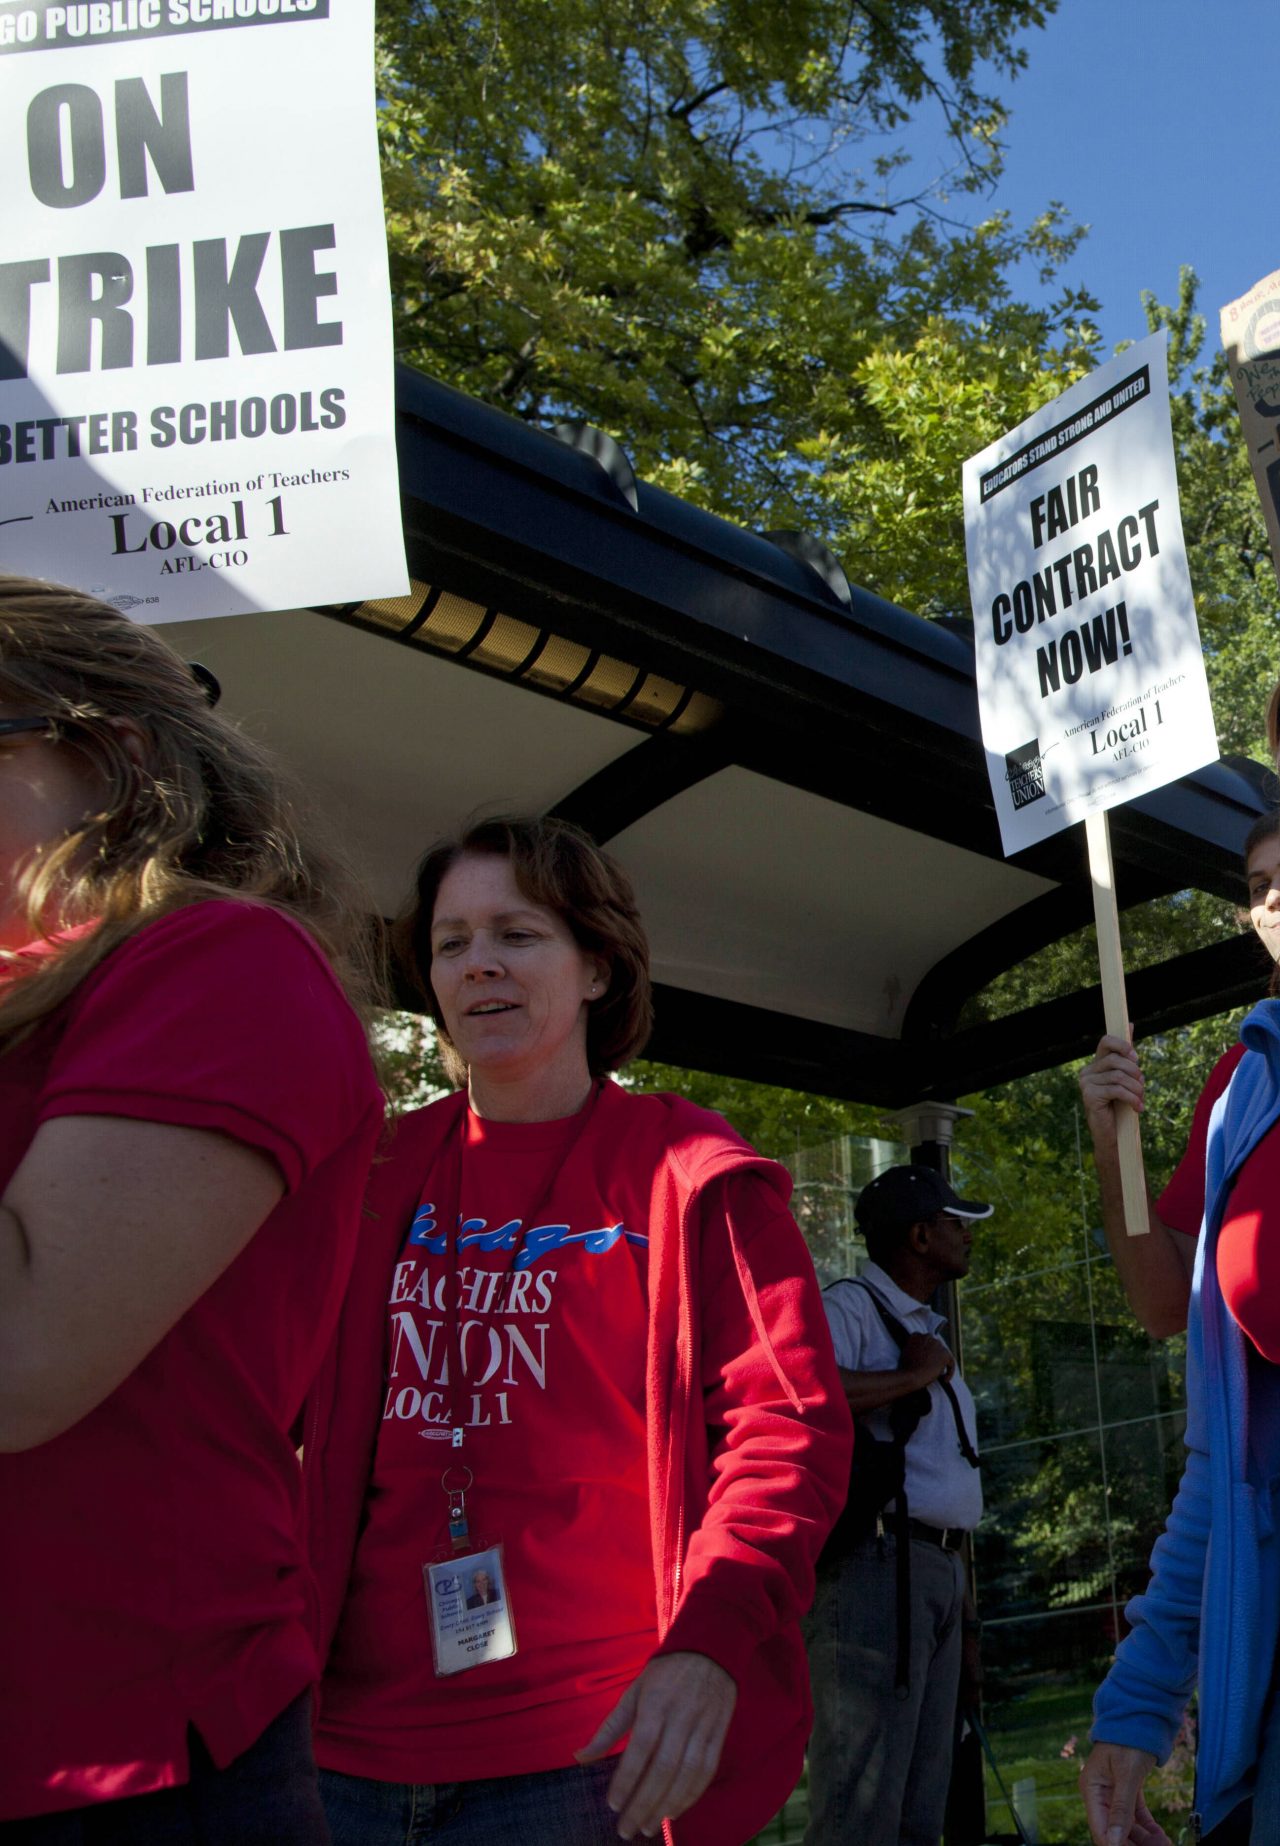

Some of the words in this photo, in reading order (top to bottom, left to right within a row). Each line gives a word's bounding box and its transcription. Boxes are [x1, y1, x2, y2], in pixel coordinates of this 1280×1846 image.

[46, 0, 161, 39] PUBLIC
[26, 70, 195, 209] ON
[0, 223, 343, 381] TRIKE
[150, 388, 347, 448] SCHOOLS
[983, 454, 1028, 496] EDUCATORS
[1029, 435, 1057, 464] STAND
[1058, 415, 1093, 446] STRONG
[1094, 400, 1112, 423] AND
[1113, 376, 1145, 409] UNITED
[45, 491, 136, 514] American
[141, 478, 240, 503] Federation
[246, 473, 264, 492] of
[268, 467, 351, 489] Teachers
[1030, 463, 1101, 550] FAIR
[108, 500, 249, 556] Local
[265, 495, 291, 538] 1
[160, 549, 249, 575] AFL-CIO
[991, 499, 1160, 646] CONTRACT
[1036, 601, 1133, 699] NOW!
[1063, 716, 1100, 739] American
[1101, 695, 1142, 722] Federation
[1143, 689, 1152, 702] of
[1152, 673, 1187, 696] Teachers
[1090, 707, 1147, 756] Local
[1155, 700, 1163, 726] 1
[1009, 766, 1043, 792] TEACHERS
[1112, 738, 1150, 764] AFL-CIO
[1012, 778, 1045, 806] UNION
[389, 1260, 557, 1314] EACHERS
[391, 1311, 550, 1390] NON
[383, 1387, 490, 1426] LOCL
[496, 1391, 512, 1424] 1
